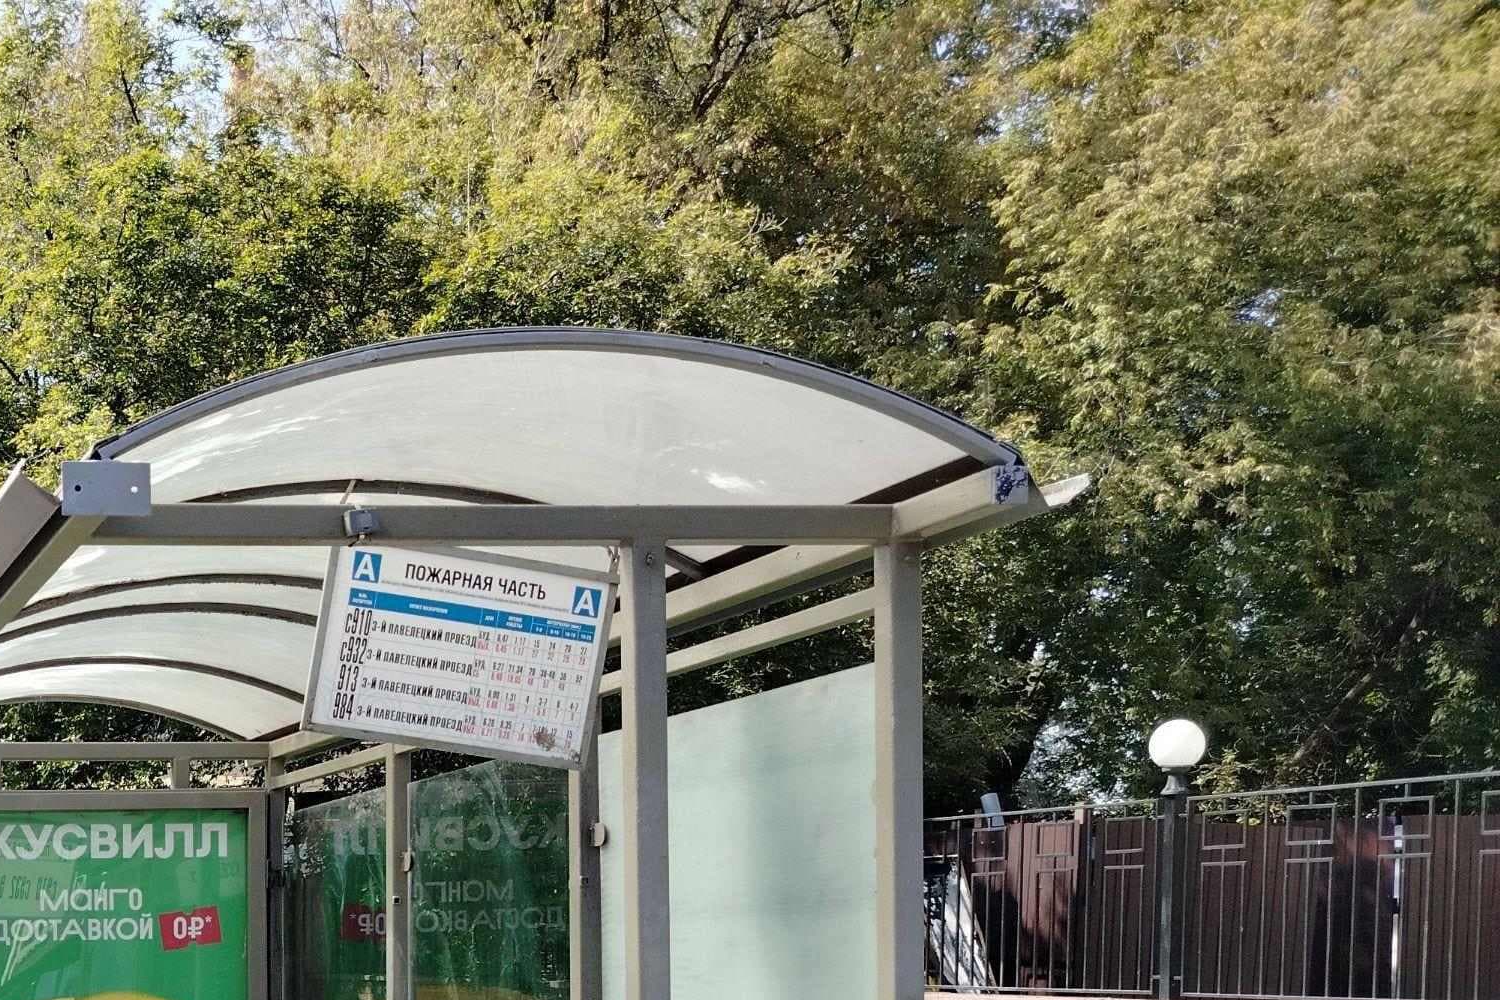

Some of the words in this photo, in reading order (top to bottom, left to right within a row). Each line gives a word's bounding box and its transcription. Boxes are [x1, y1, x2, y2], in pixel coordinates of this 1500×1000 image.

[353, 553, 379, 581] А
[404, 563, 493, 591] ПОЖАРНАЯ
[498, 577, 546, 600] ЧАСТЬ
[573, 588, 598, 615] А
[387, 622, 442, 643] ПАВЕЛЕЦКИЙ
[443, 632, 477, 648] ПРОЕЗД
[339, 635, 367, 664] с932
[382, 650, 438, 671] ПАВЕЛЕЦКИЙ
[438, 659, 473, 676] ПРОЕЗД
[337, 664, 359, 691] 913
[377, 679, 433, 699] ПАВЕЛЕЦКИЙ
[434, 688, 468, 704] ПРОЕЗД
[332, 692, 355, 720] 984
[373, 707, 428, 728] ПАВЕЛЕЦКИЙ
[429, 716, 463, 732] ПРОЕЗД
